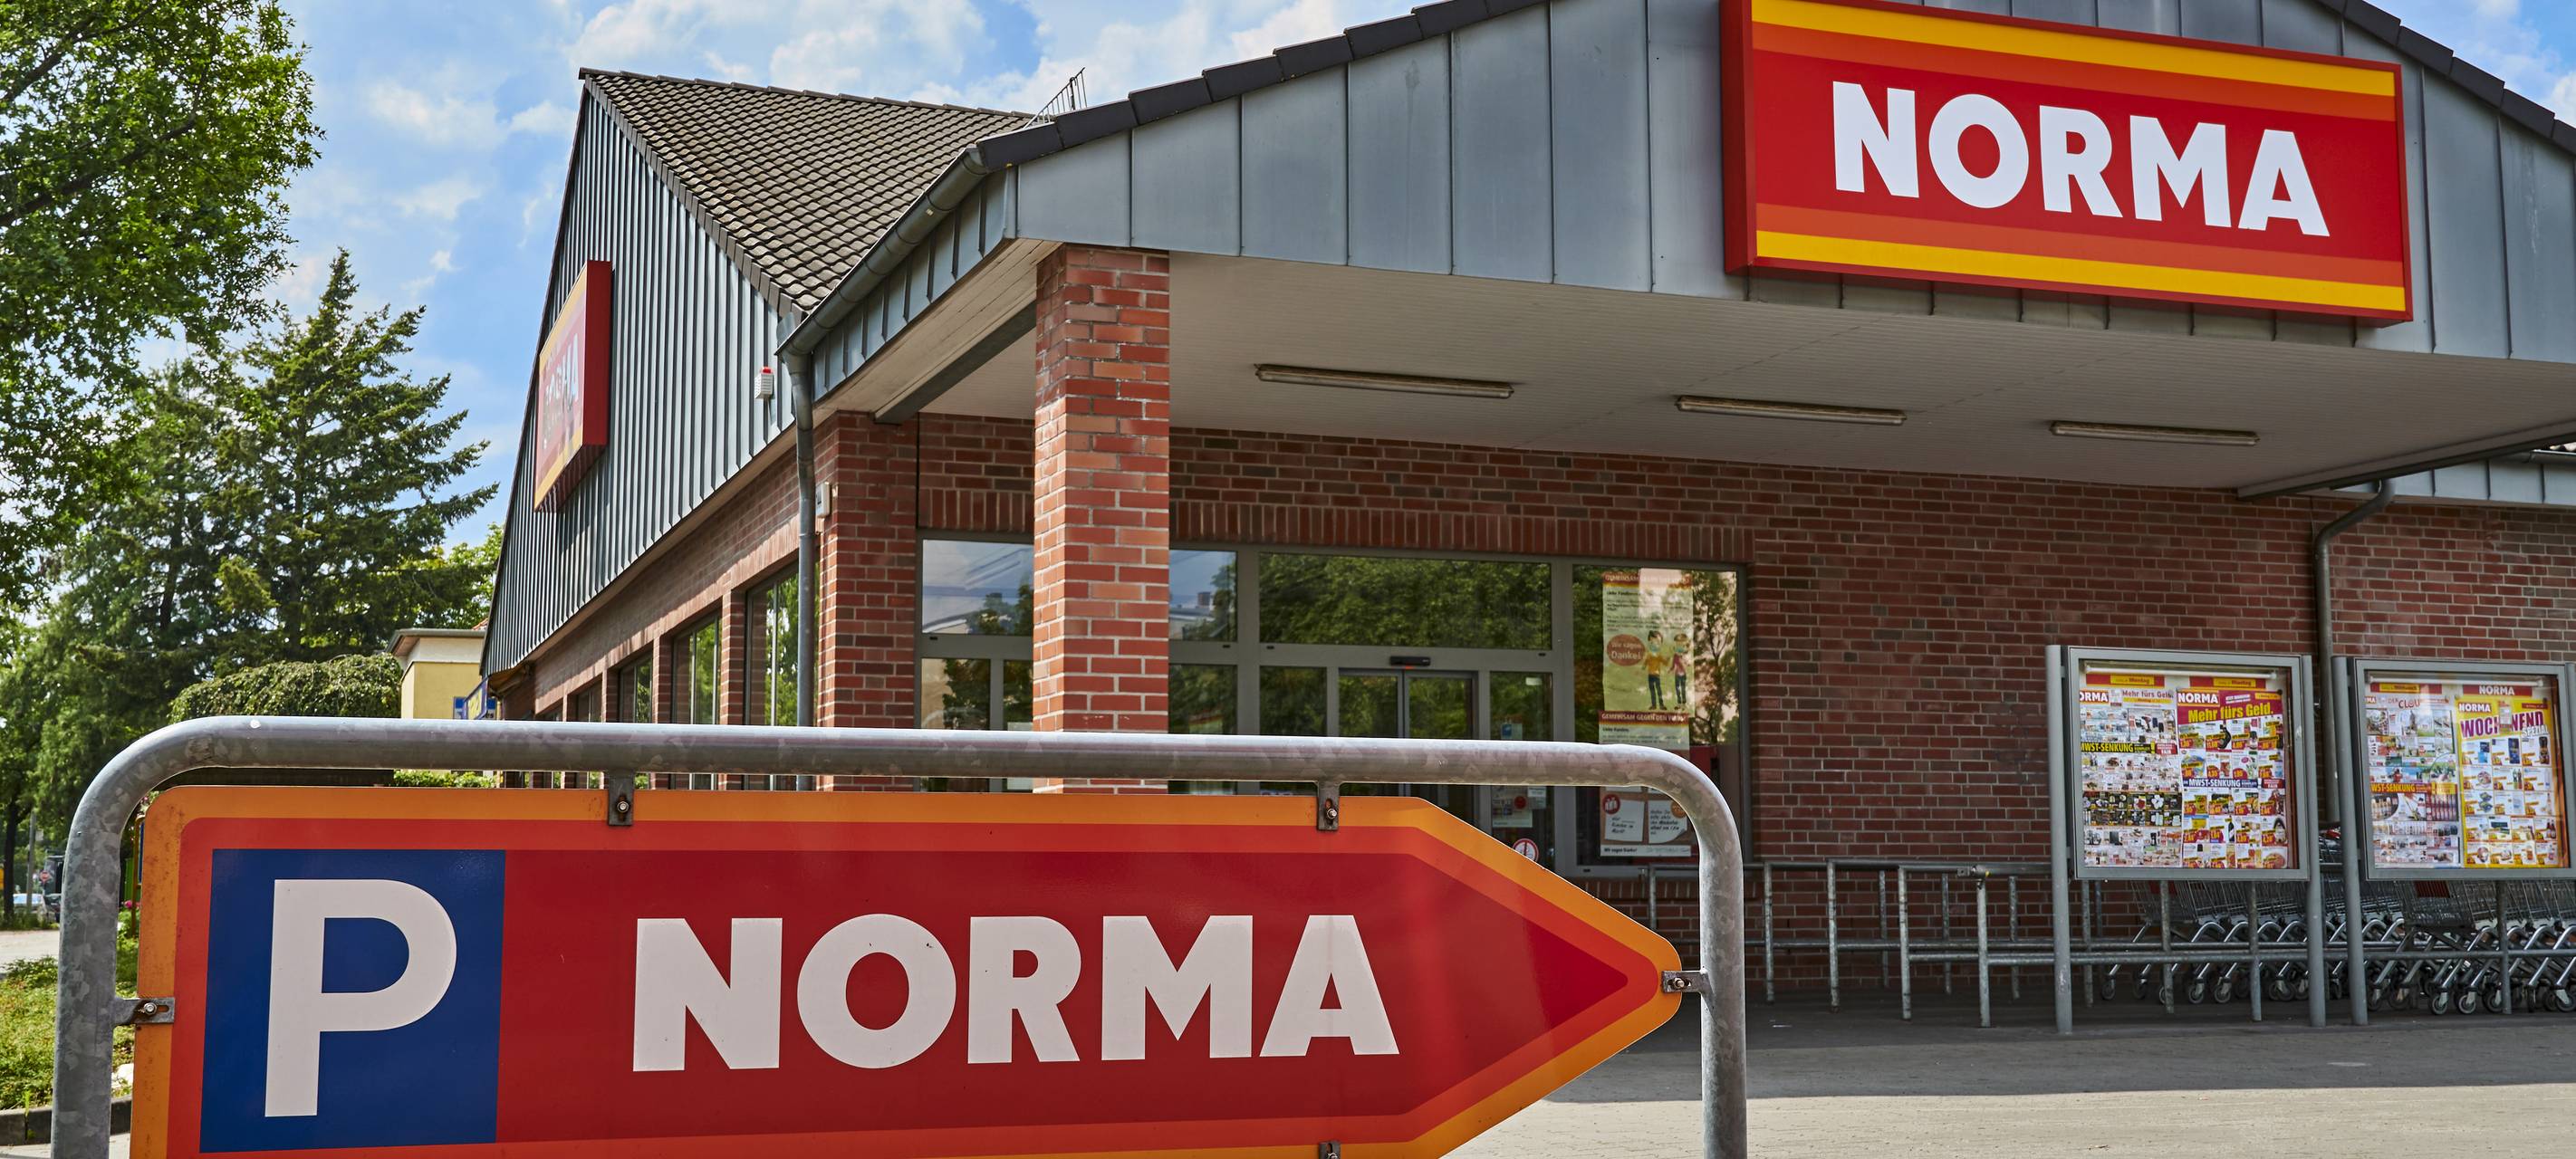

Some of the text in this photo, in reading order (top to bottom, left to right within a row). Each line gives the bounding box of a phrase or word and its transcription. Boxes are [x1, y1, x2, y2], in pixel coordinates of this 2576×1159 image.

[1833, 81, 2330, 236] NORMA
[2479, 685, 2514, 695] NORMA
[2080, 692, 2109, 702] ORMA
[2177, 693, 2218, 704] NORMA
[2187, 702, 2273, 723] Mehr fürs Geld.
[2458, 703, 2491, 713] NORMA
[2460, 711, 2544, 738] WOCNEND
[2522, 724, 2549, 737] SPEZIAL
[2188, 779, 2241, 788] MWST-SENKUNG
[2370, 783, 2416, 792] WST-SENKUNG
[265, 880, 1399, 1116] P NORMA
